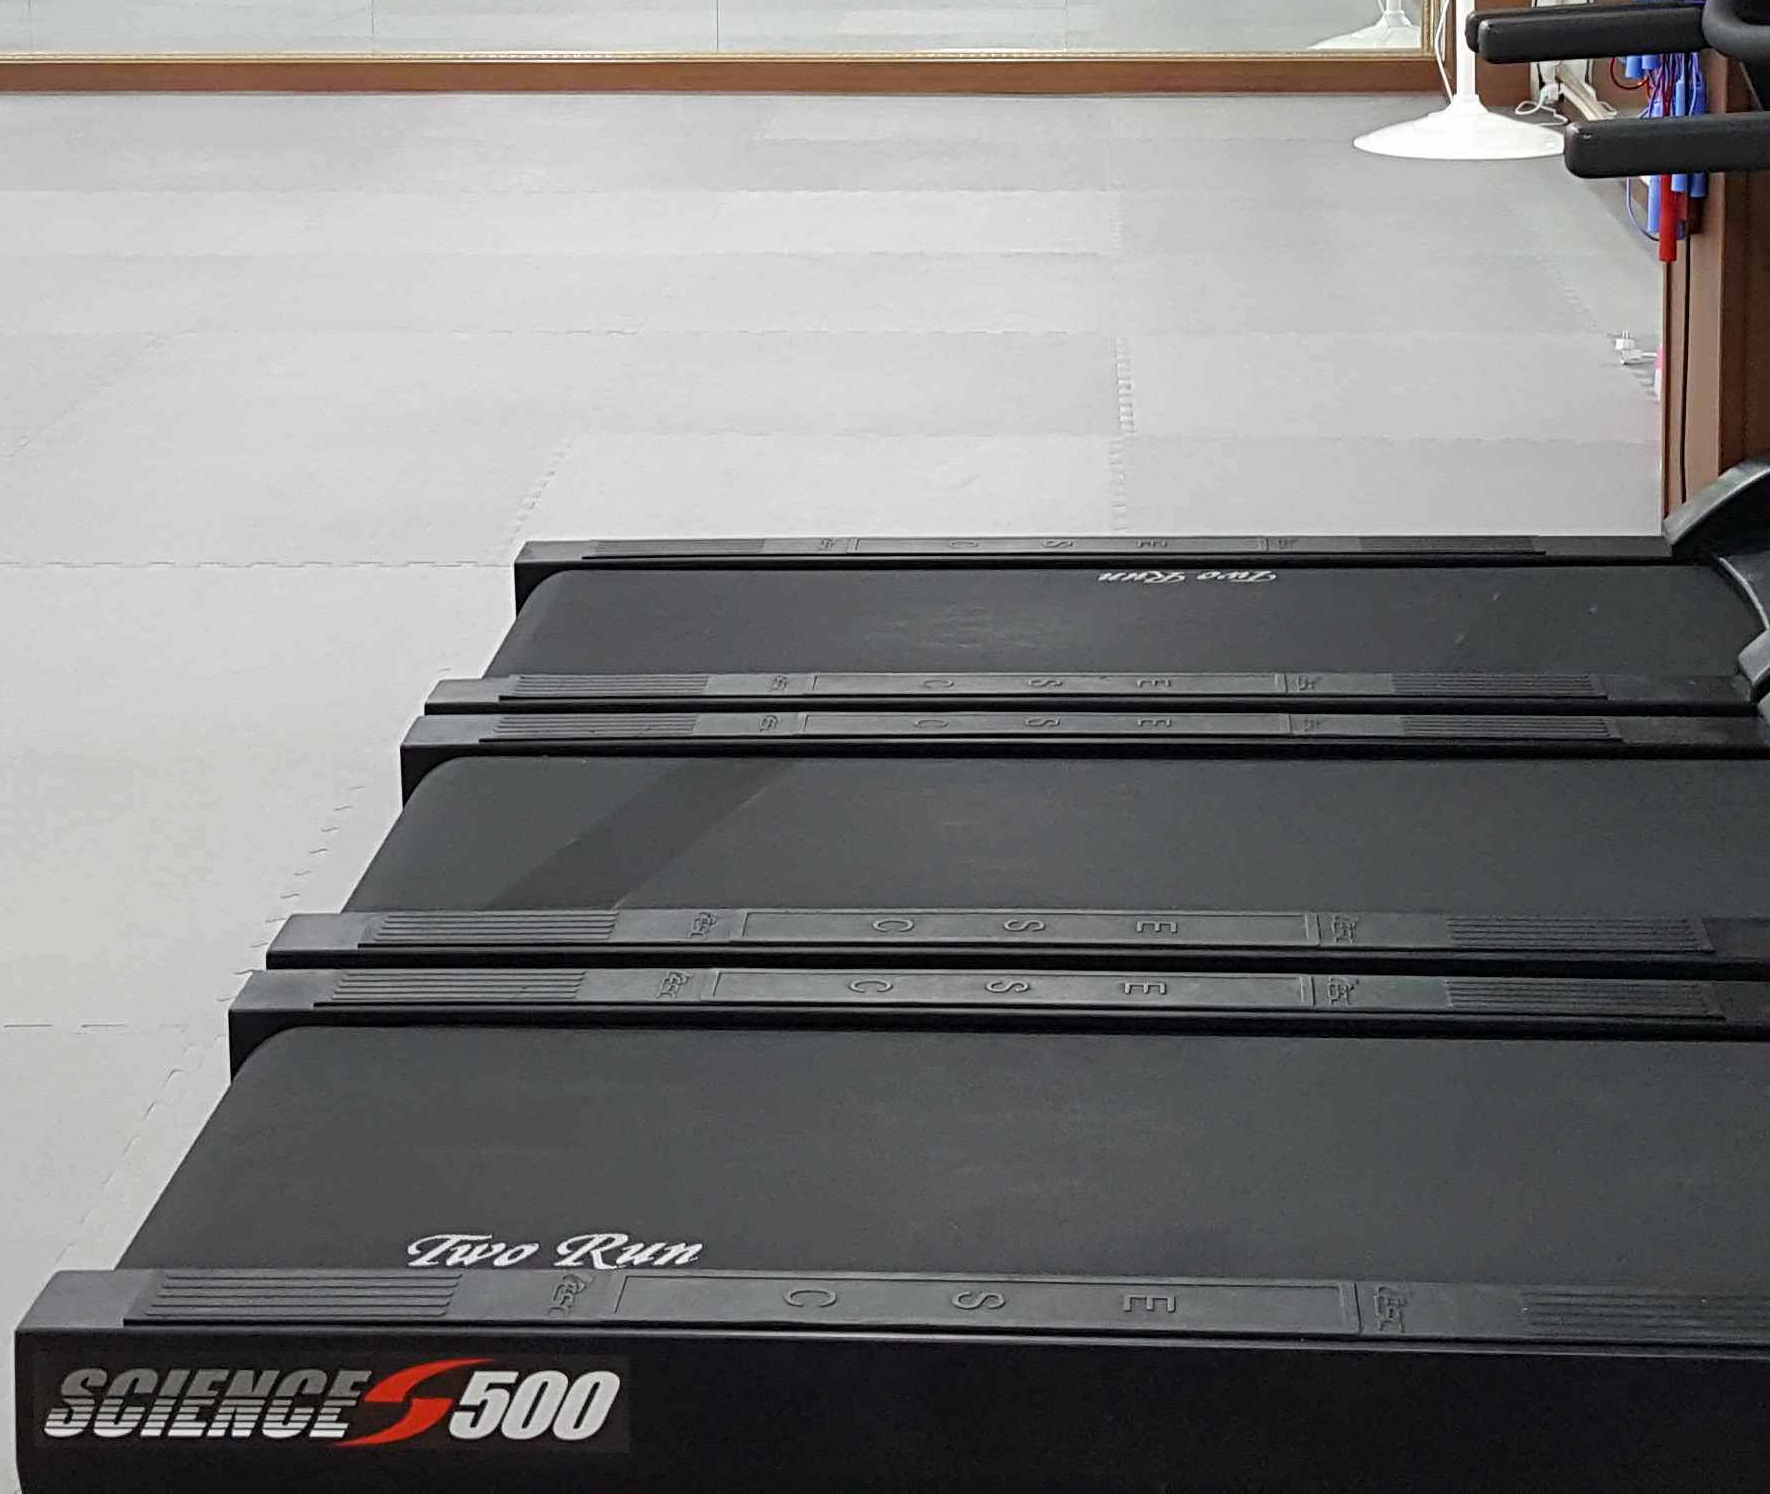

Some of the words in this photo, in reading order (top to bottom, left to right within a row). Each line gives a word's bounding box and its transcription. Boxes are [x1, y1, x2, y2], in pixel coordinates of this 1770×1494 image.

[407, 1232, 540, 1269] Two
[555, 1232, 704, 1270] Run
[43, 1367, 372, 1440] SCIENCE
[448, 1370, 621, 1441] 500
